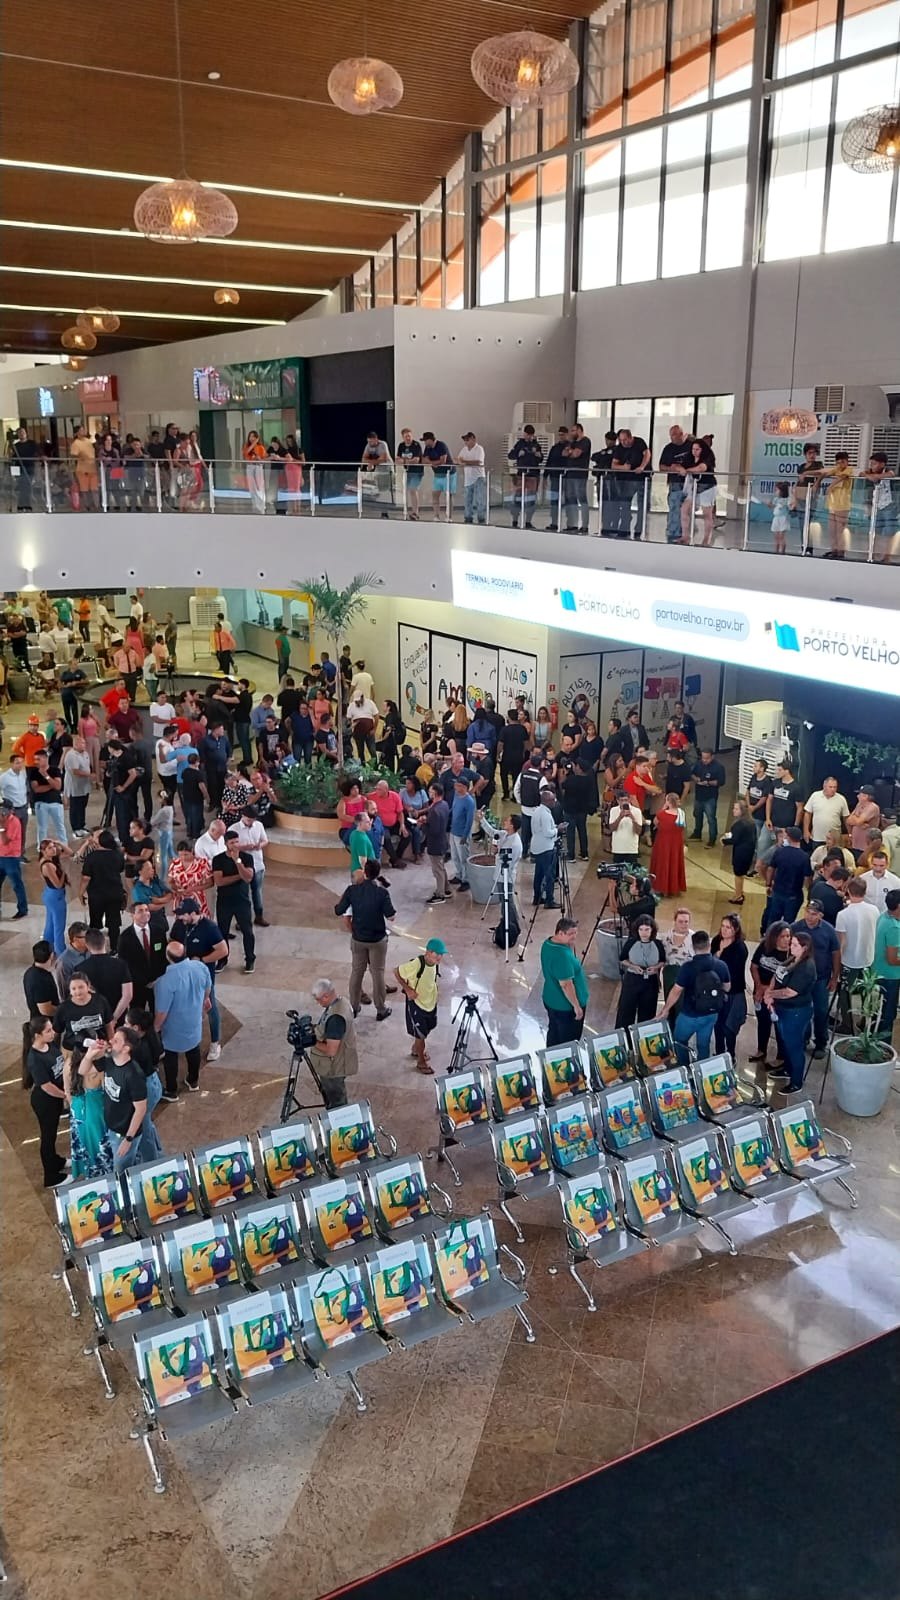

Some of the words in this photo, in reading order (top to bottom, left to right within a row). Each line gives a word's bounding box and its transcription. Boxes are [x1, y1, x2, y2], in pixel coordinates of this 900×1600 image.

[764, 442, 802, 457] mais
[464, 572, 490, 585] TERMINAL
[578, 599, 608, 615] PORTO
[608, 603, 641, 620] VELHO
[655, 607, 745, 633] portovelho.ro.gov.br
[803, 636, 849, 656] PORTO
[851, 643, 900, 665] VELHO
